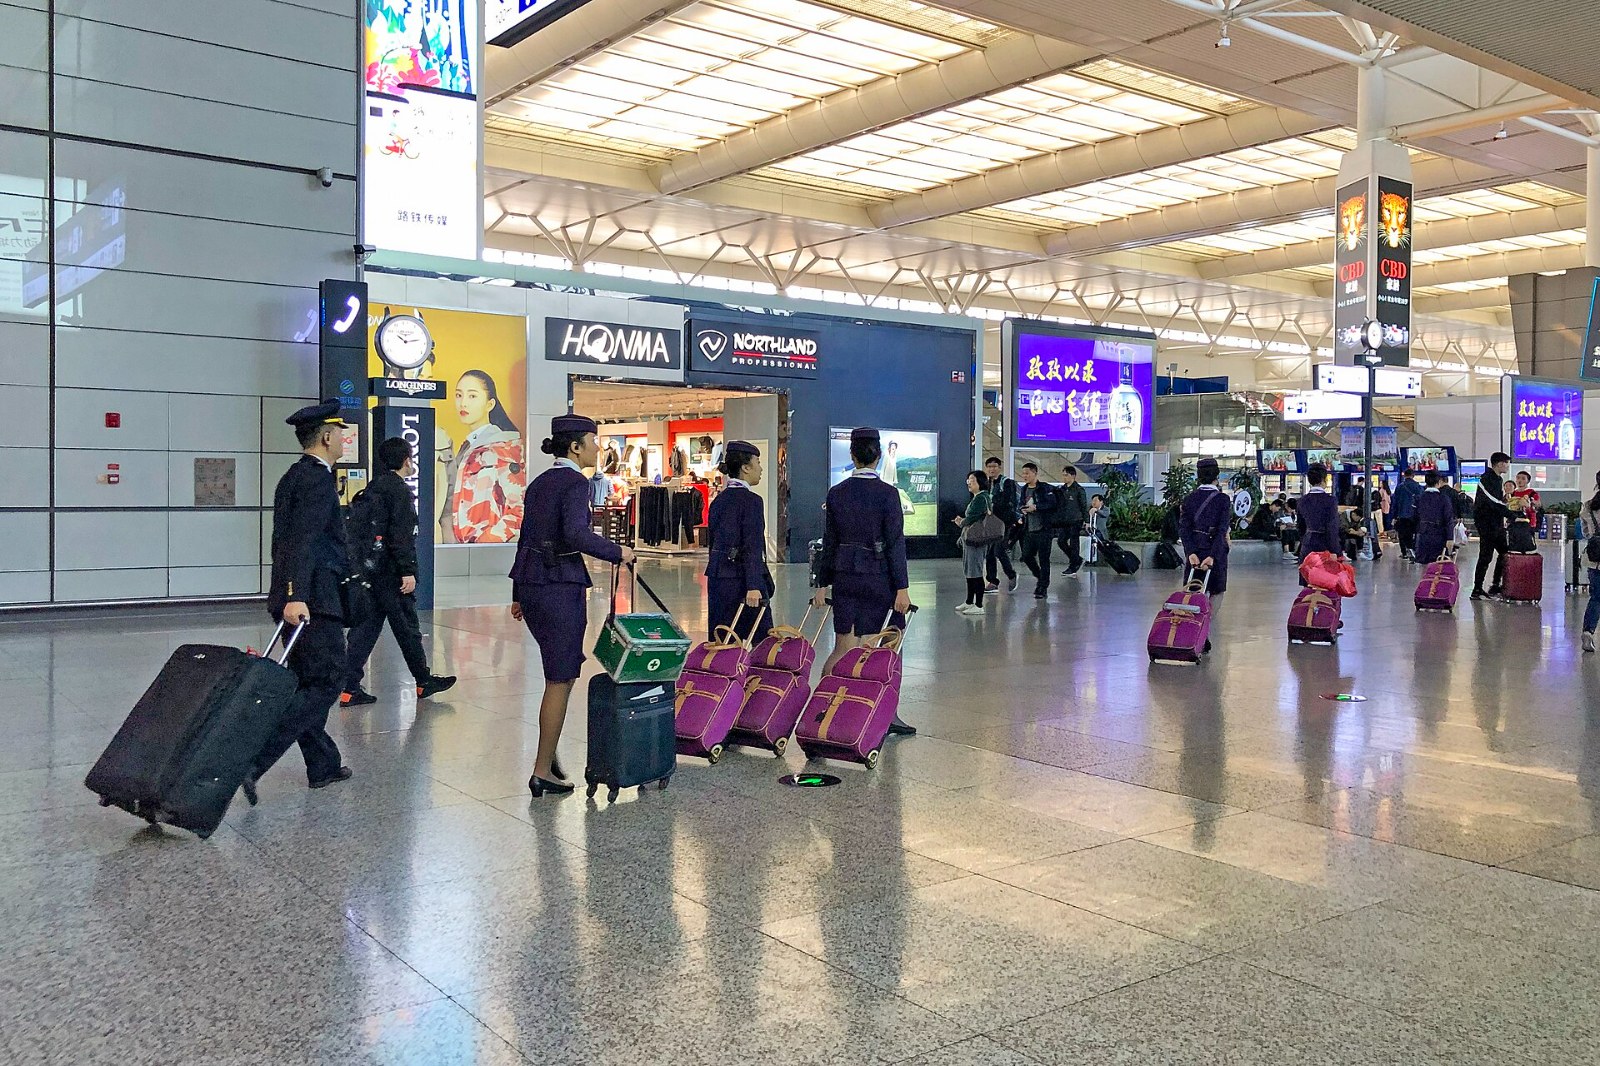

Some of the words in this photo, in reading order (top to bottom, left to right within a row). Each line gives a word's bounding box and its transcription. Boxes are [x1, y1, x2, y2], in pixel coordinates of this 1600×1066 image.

[1340, 260, 1364, 281] CBD
[1380, 258, 1407, 279] CBD
[561, 323, 670, 363] HONMA
[733, 332, 817, 356] NORTHLAND
[732, 357, 817, 370] PROFESSIONAL
[1026, 354, 1098, 384] 孜孜以求
[386, 380, 437, 391] LONGINES
